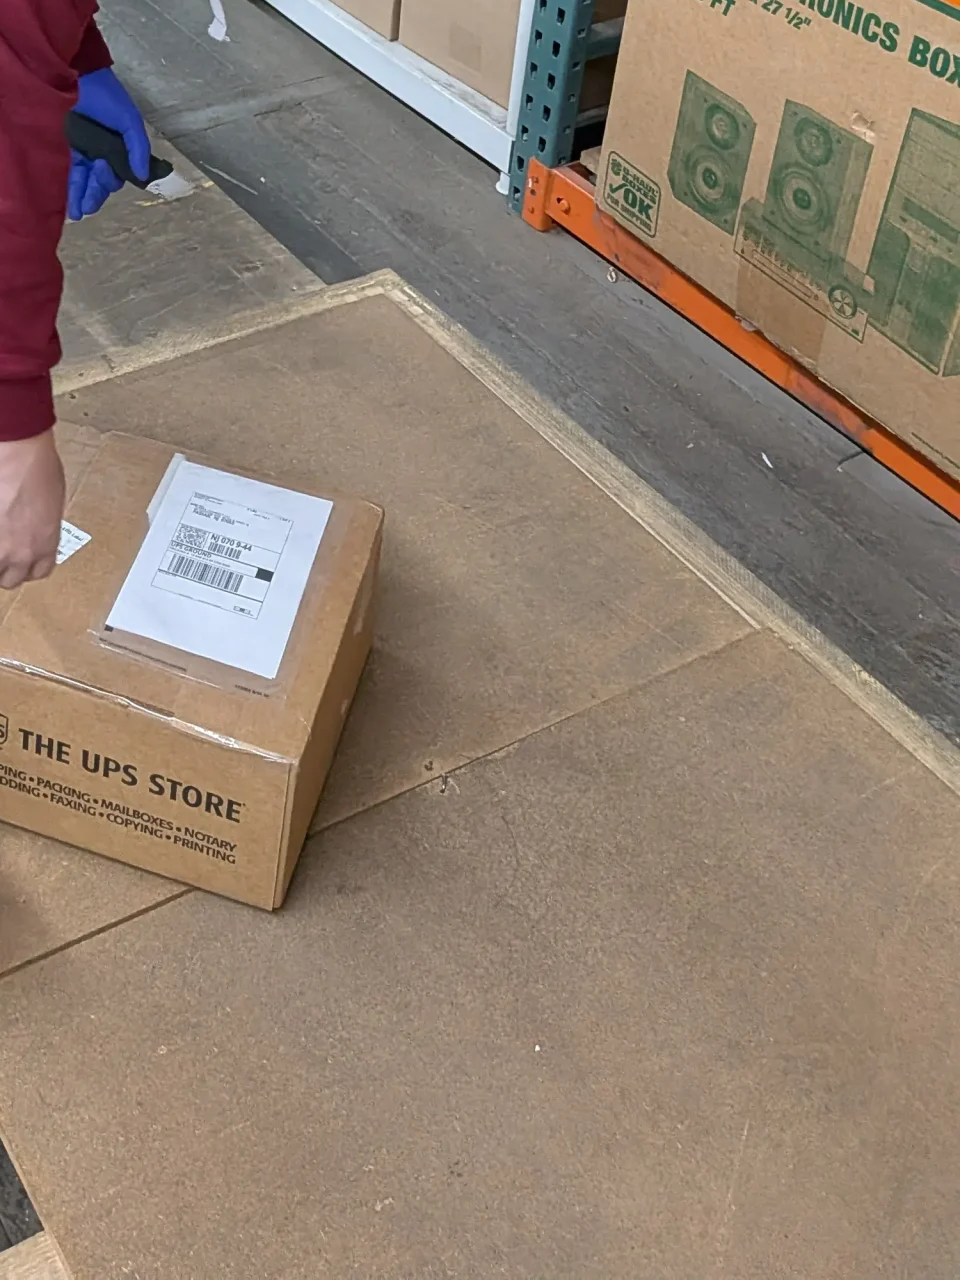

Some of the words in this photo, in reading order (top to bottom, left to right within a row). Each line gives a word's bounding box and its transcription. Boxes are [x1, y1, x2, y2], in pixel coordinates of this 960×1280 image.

[785, 7, 812, 31] 1/2"
[622, 174, 657, 205] BOXES
[623, 187, 653, 223] OK
[171, 541, 183, 550] UPS
[184, 546, 212, 559] GROUND
[211, 533, 221, 543] NJ
[221, 537, 235, 547] 070
[235, 542, 252, 551] 9-44
[18, 727, 71, 766] THE
[81, 748, 139, 787] UPS
[148, 773, 242, 824] STORE
[36, 775, 91, 805] PACKING
[100, 798, 174, 833] MAILBOXES
[183, 826, 237, 854] NOTARY
[49, 791, 97, 819] FAXING
[105, 811, 164, 841] COPYING
[172, 834, 237, 866] PRINTING
